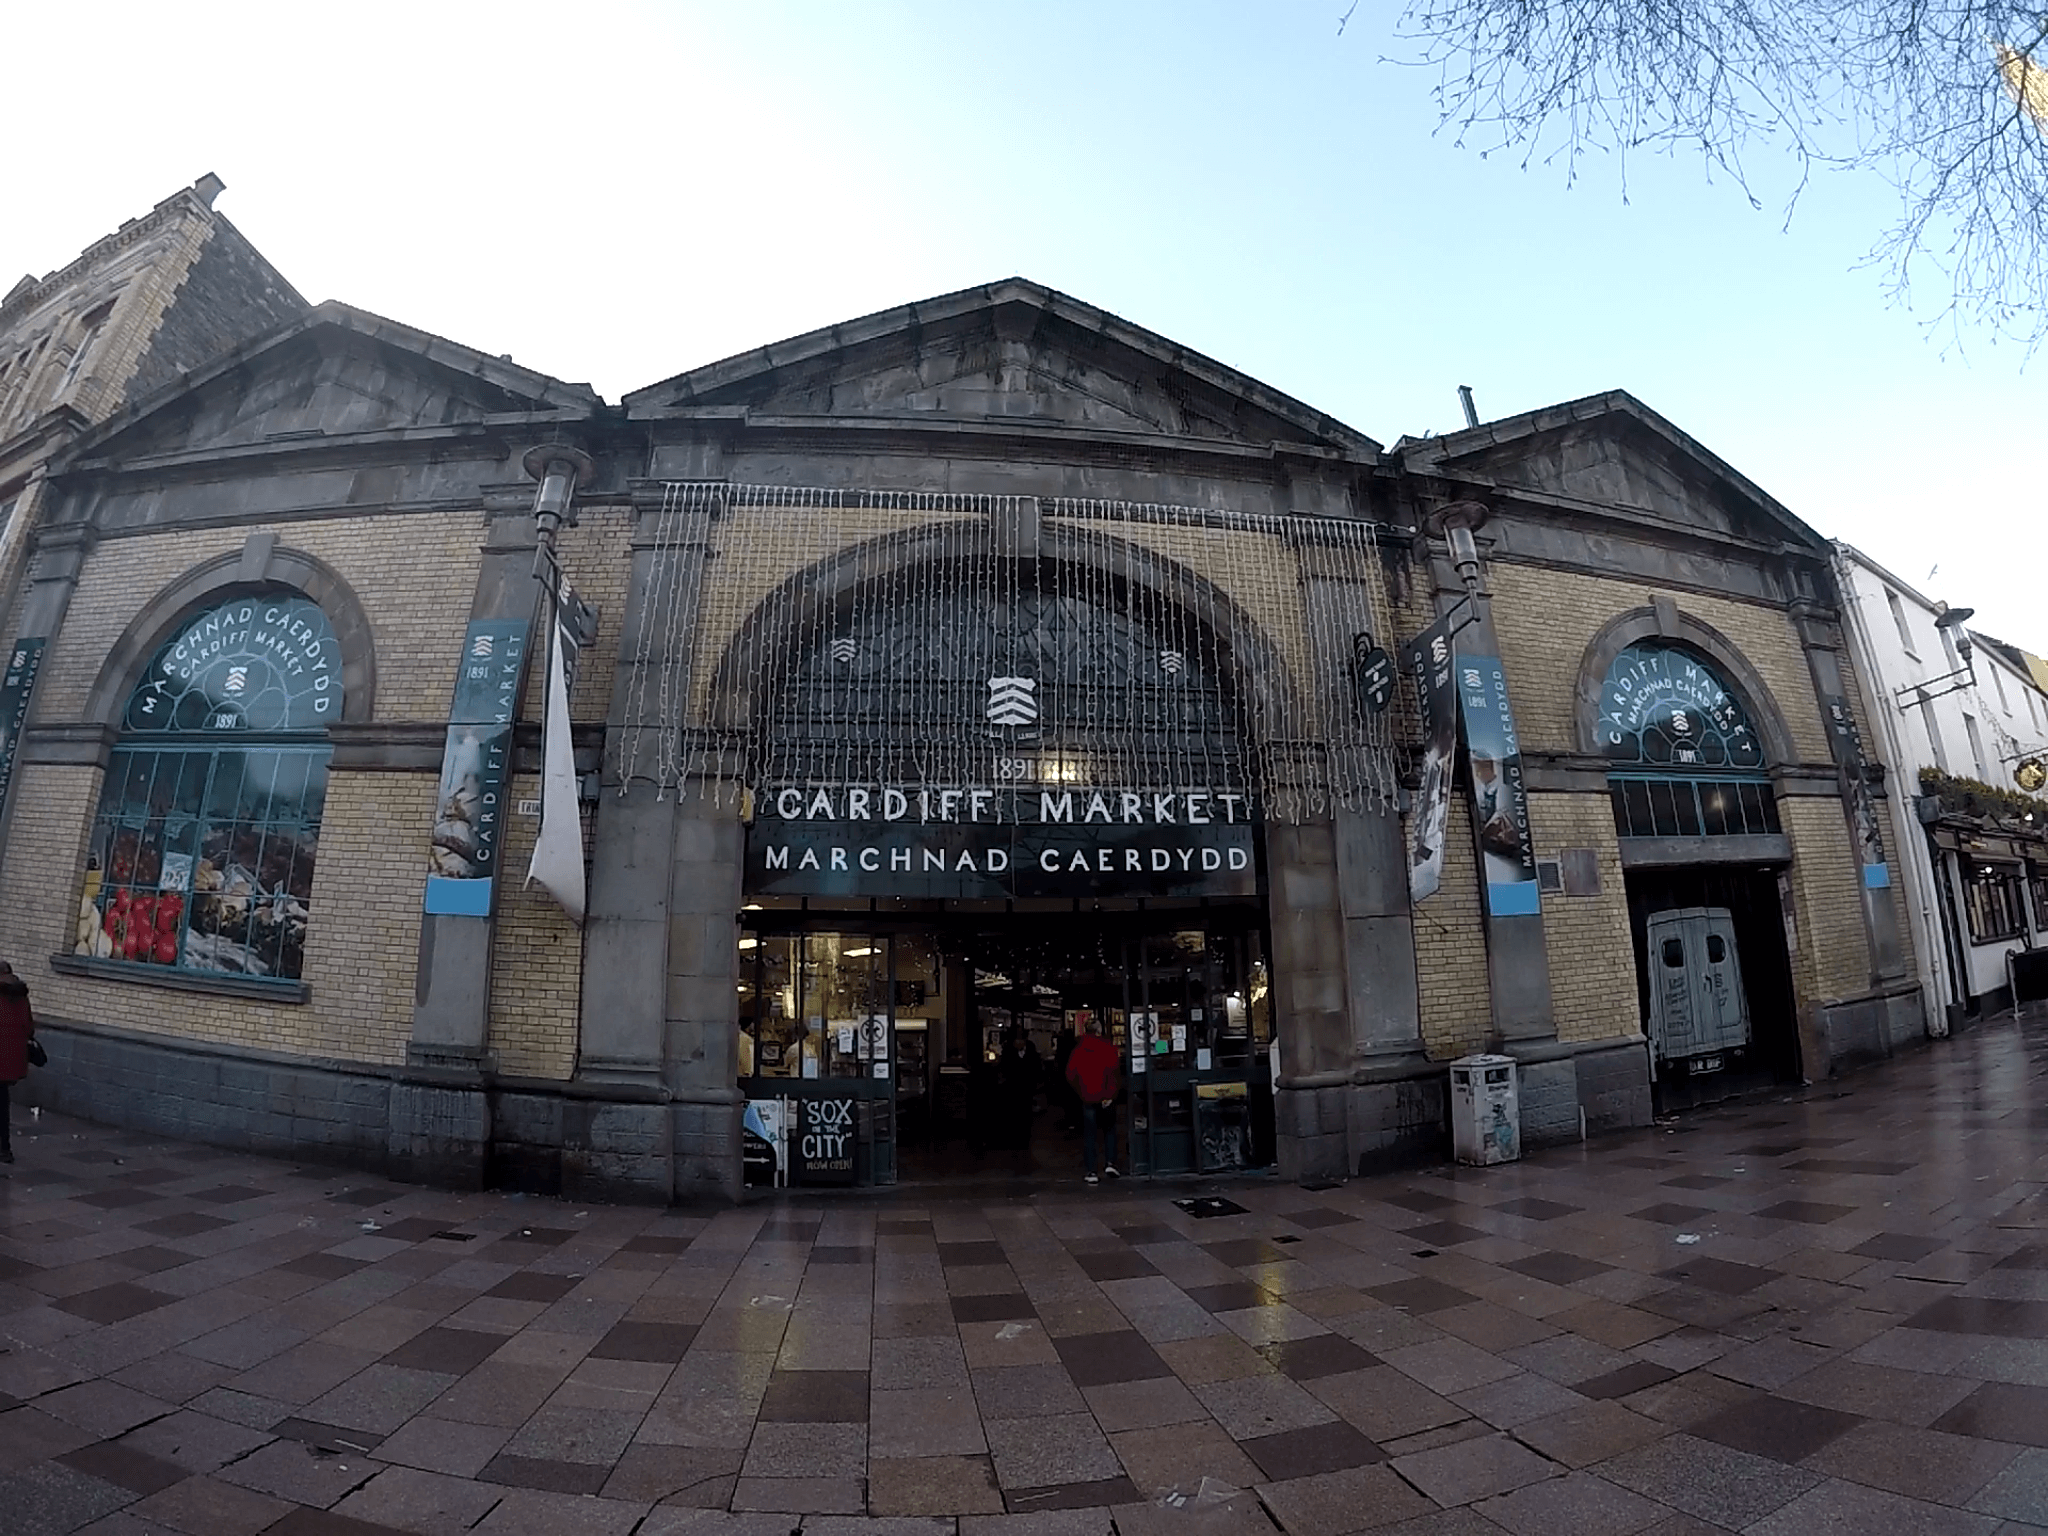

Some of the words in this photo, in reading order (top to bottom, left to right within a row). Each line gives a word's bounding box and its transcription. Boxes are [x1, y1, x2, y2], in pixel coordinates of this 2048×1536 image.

[142, 608, 251, 713] MARCHNAD
[265, 608, 329, 712] CAERDYDD
[181, 630, 248, 679] CARDIFF
[255, 631, 303, 676] MARKET
[467, 666, 489, 679] 1891
[215, 714, 238, 728] 1891
[1468, 695, 1487, 708] 1891
[1492, 671, 1517, 756] CAERDYDD
[1609, 658, 1658, 745] CARDIFF
[1686, 665, 1752, 752] MARKET
[1628, 678, 1672, 724] MARCHNAD
[1676, 680, 1727, 730] CAERDYDD
[477, 745, 503, 862] CARDIFF
[495, 635, 521, 724] MARKET
[993, 758, 1031, 780] 1891
[777, 789, 993, 822] CARDIFF
[1040, 793, 1240, 824] MARKET
[1510, 767, 1533, 867] MARCHNAD
[765, 845, 1008, 872] MARCHNAD
[1040, 848, 1247, 872] CAERDYDD
